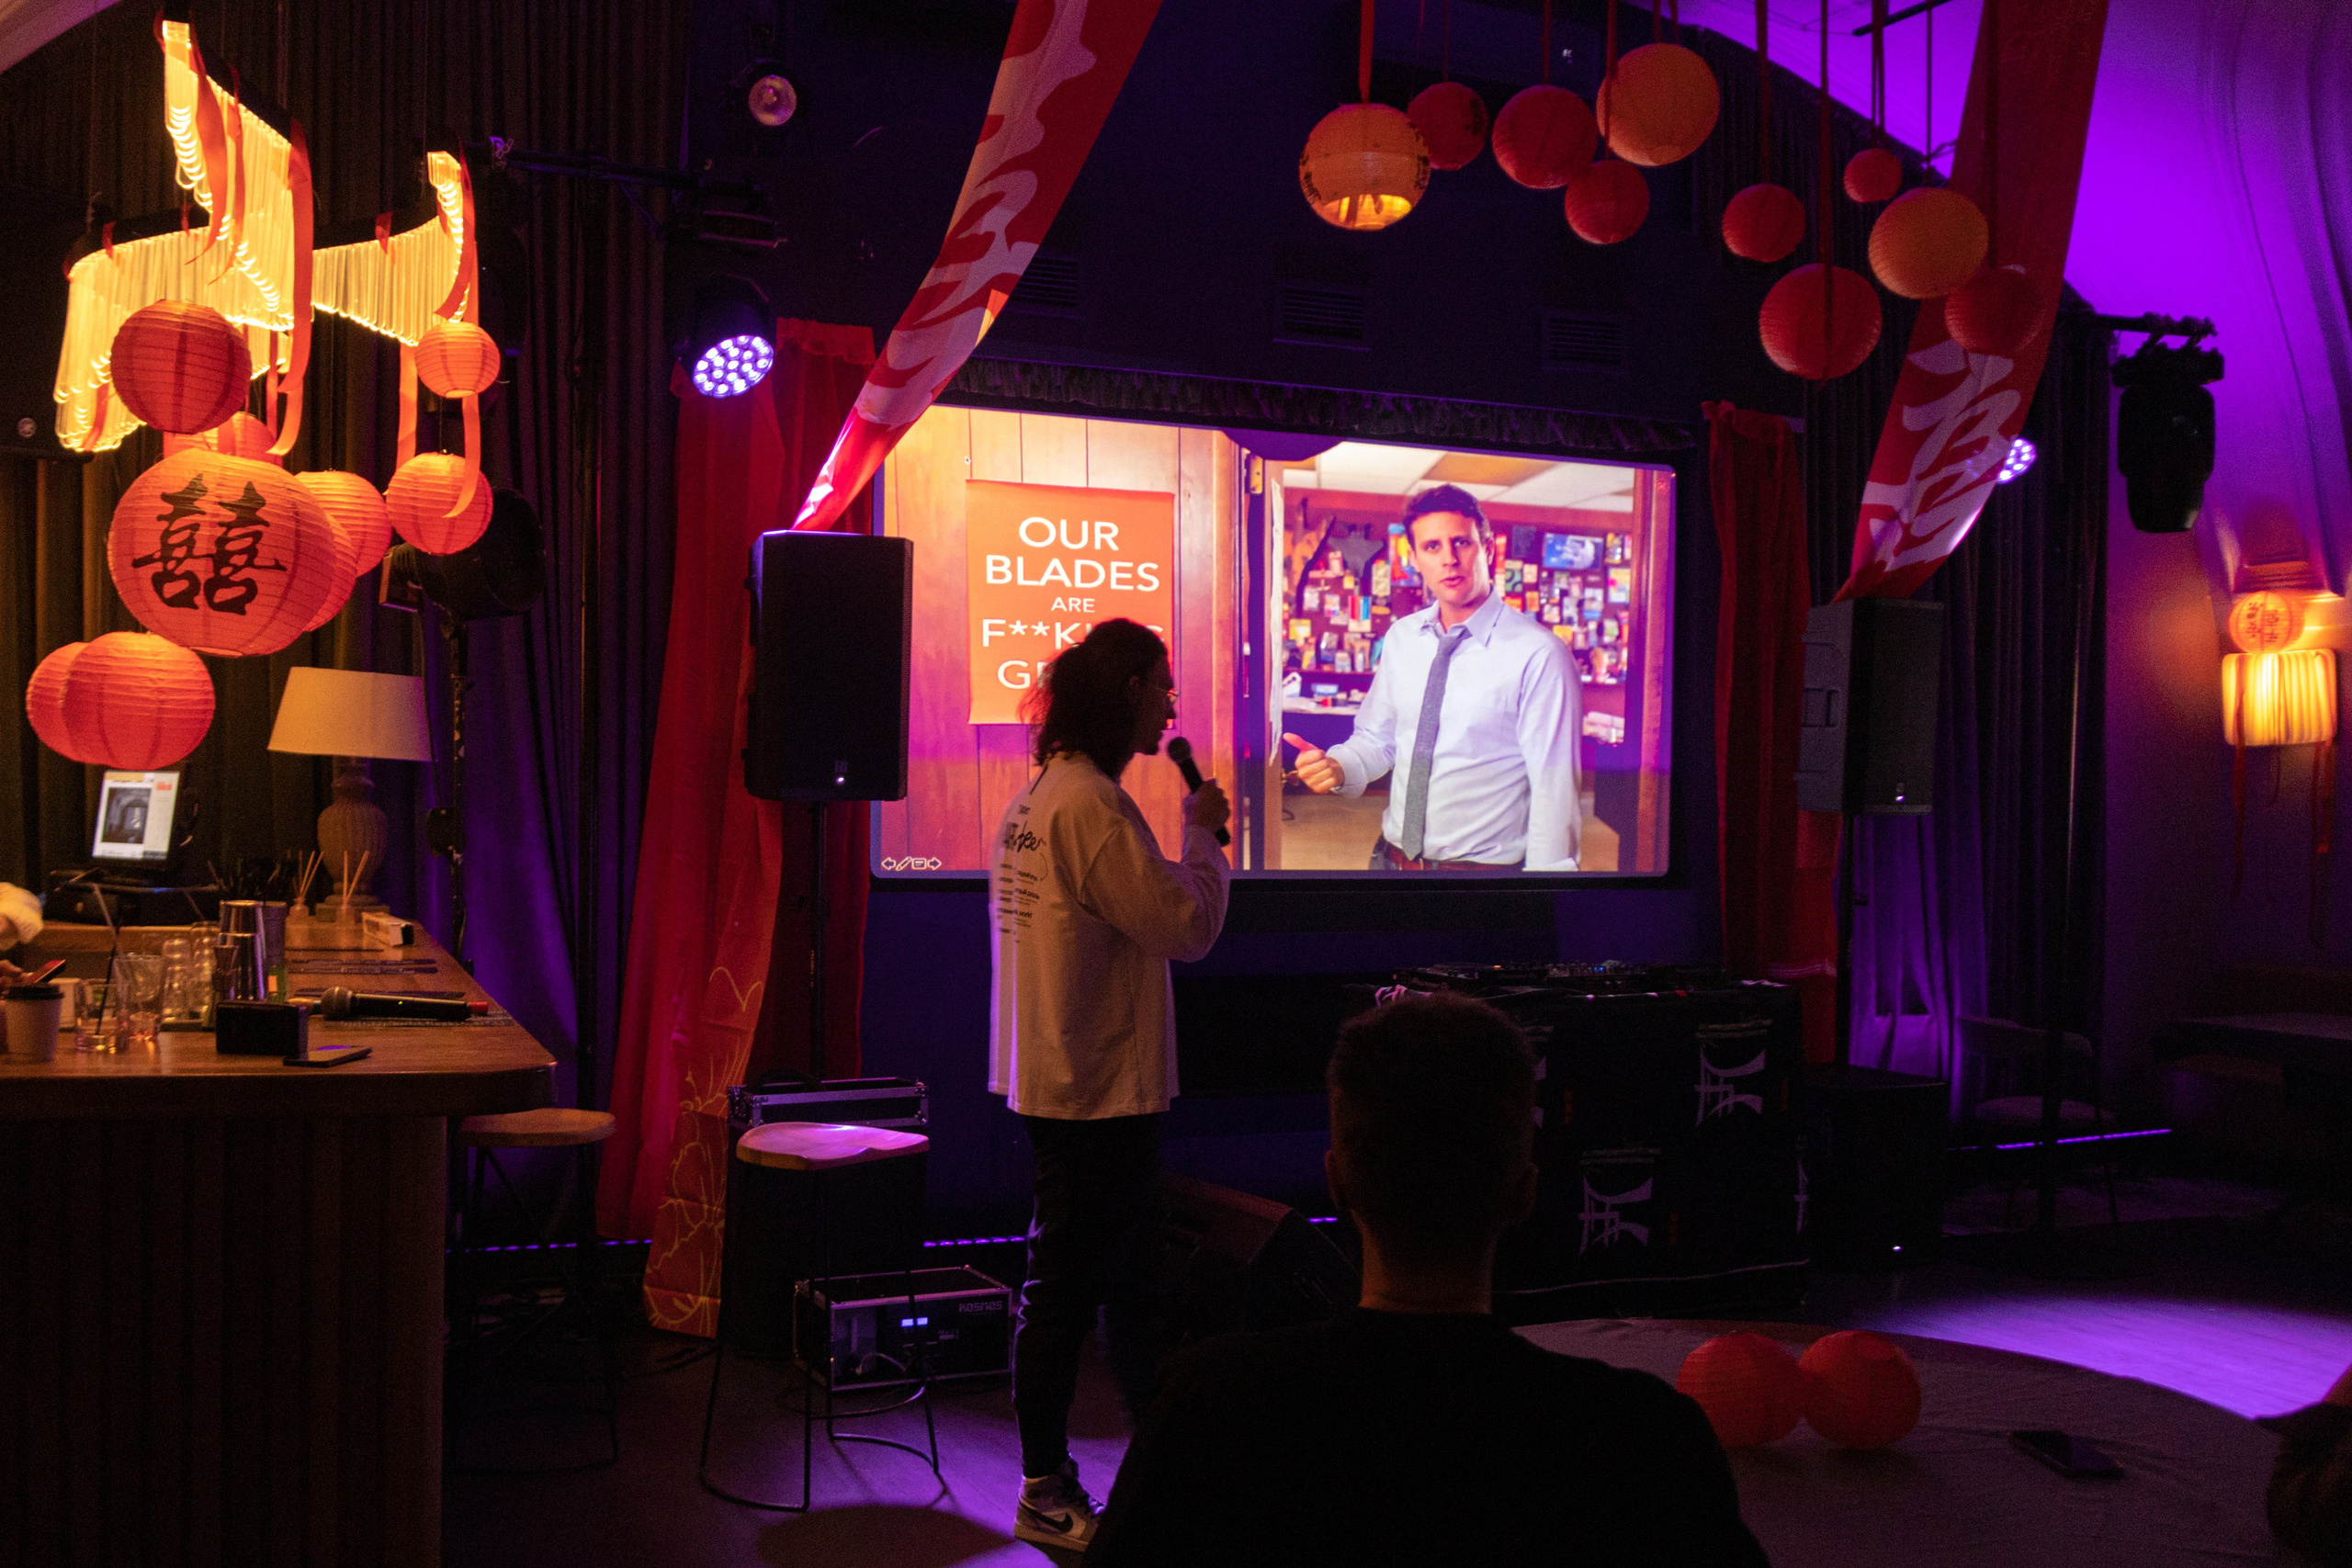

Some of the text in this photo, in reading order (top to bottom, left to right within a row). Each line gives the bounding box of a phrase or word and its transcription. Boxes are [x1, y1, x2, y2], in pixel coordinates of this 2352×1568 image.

[1019, 516, 1119, 551] OUR
[986, 555, 1159, 592] BLADES
[1050, 596, 1096, 613] ARE
[958, 1300, 1003, 1314] KOSMOS
